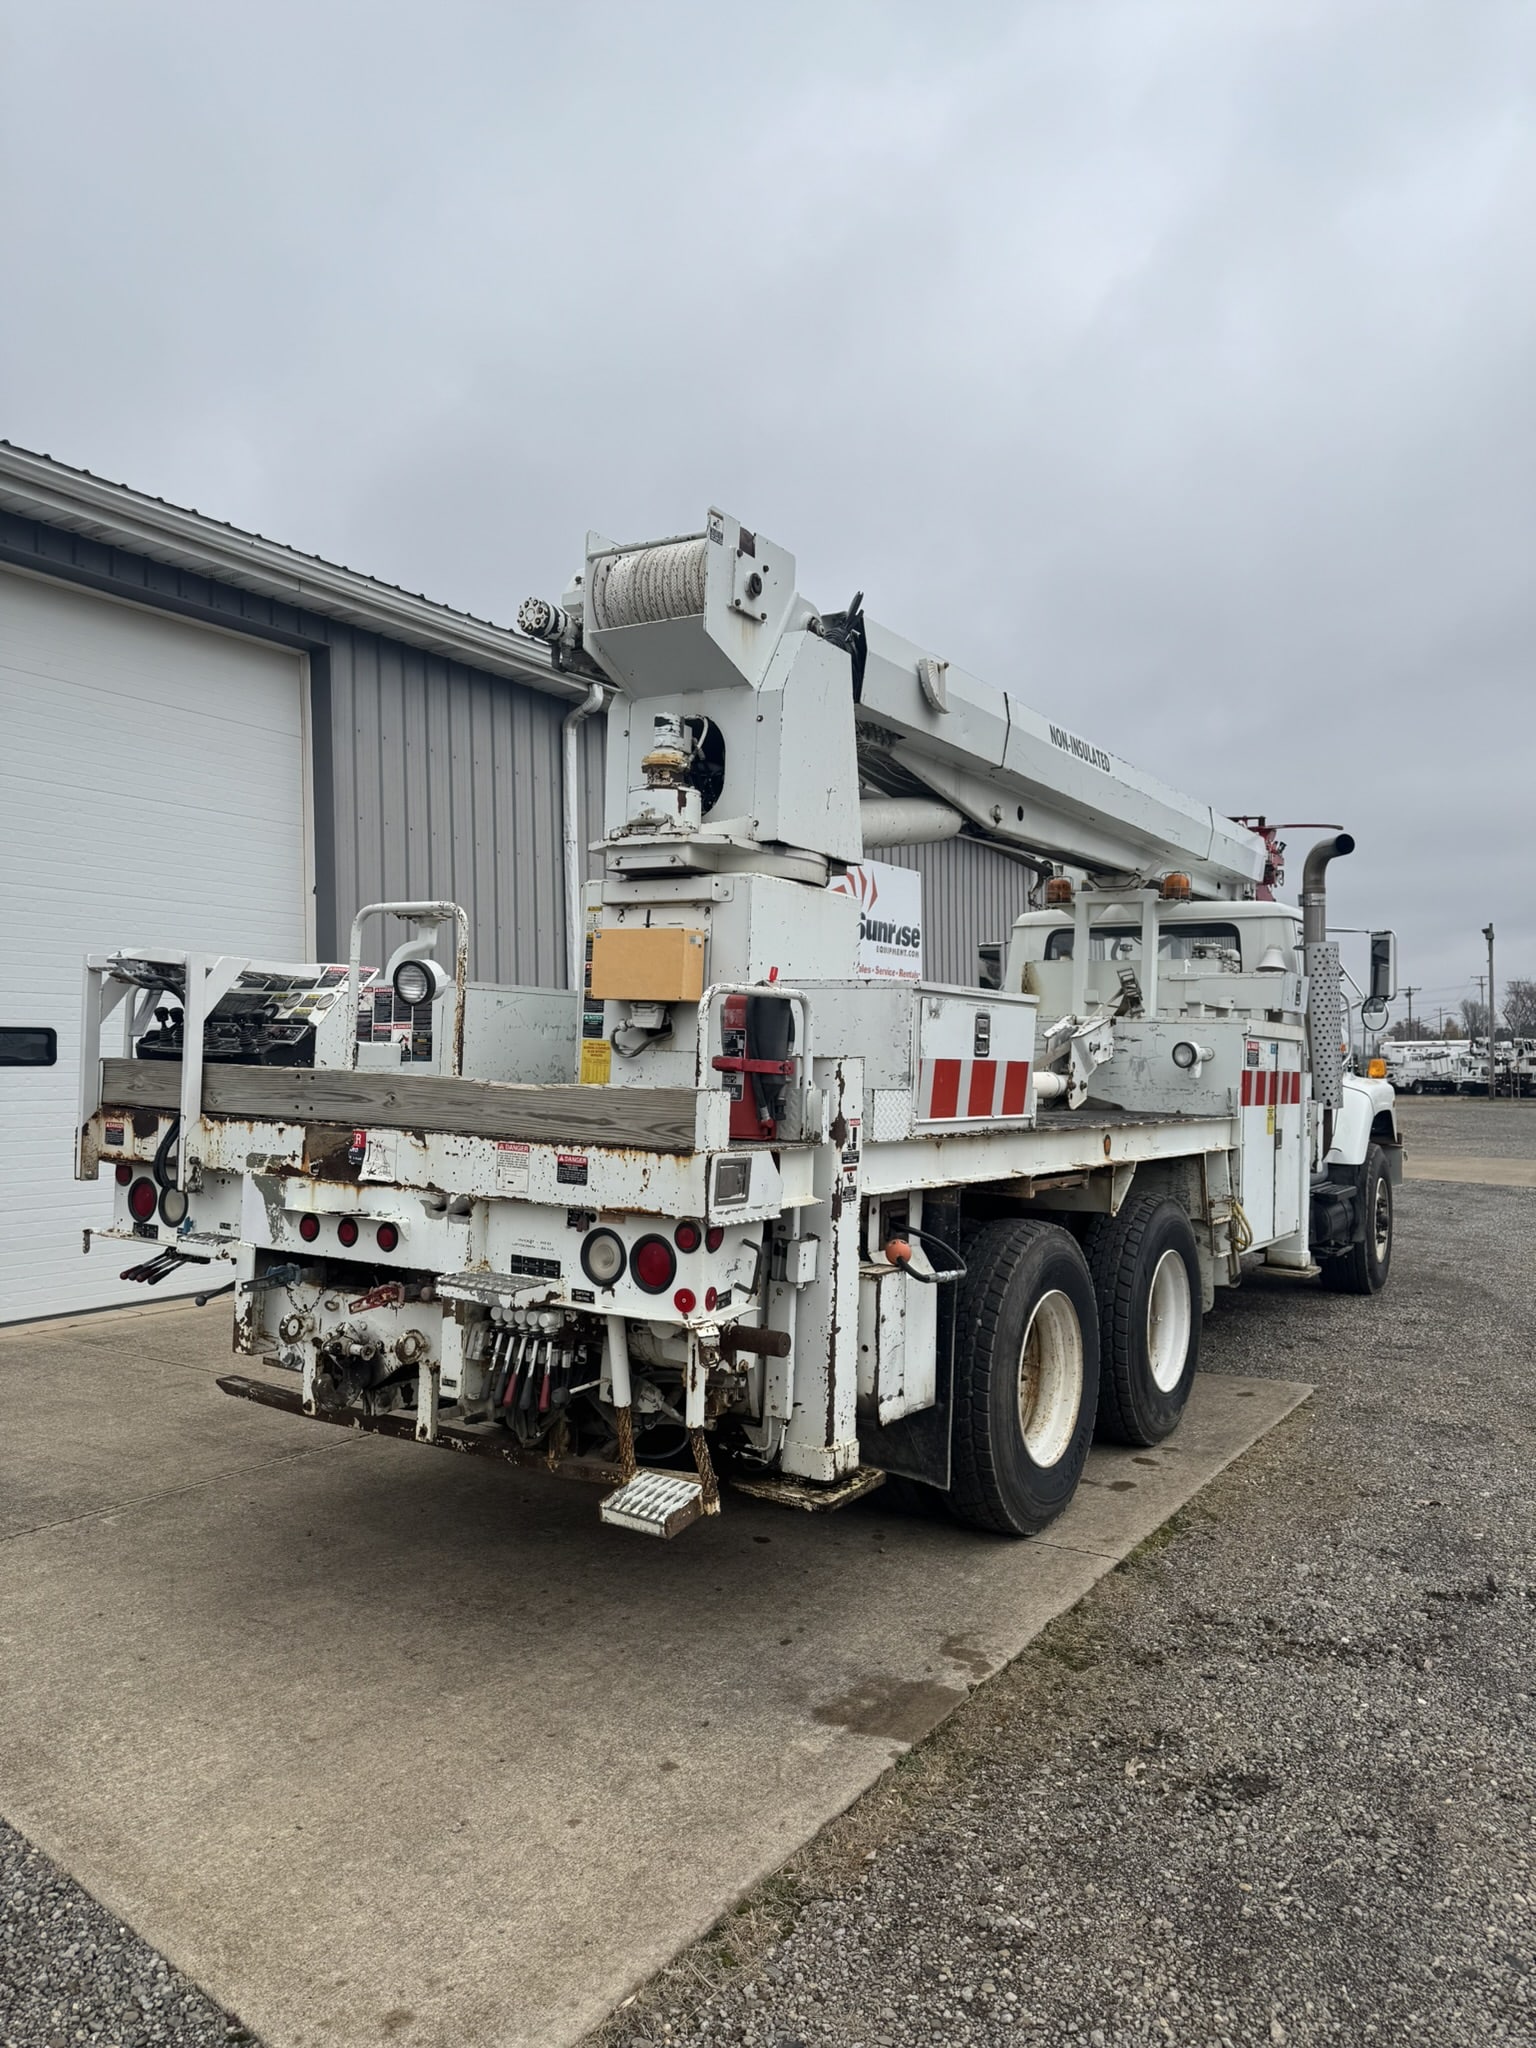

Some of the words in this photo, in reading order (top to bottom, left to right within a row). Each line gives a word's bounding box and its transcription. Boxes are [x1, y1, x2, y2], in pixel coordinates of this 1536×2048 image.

[1048, 723, 1111, 773] NON-INSULATED
[876, 945, 920, 958] EQUIPMENT.COM
[858, 964, 871, 974] ales
[874, 965, 896, 977] Service
[505, 1143, 529, 1152] DANGER
